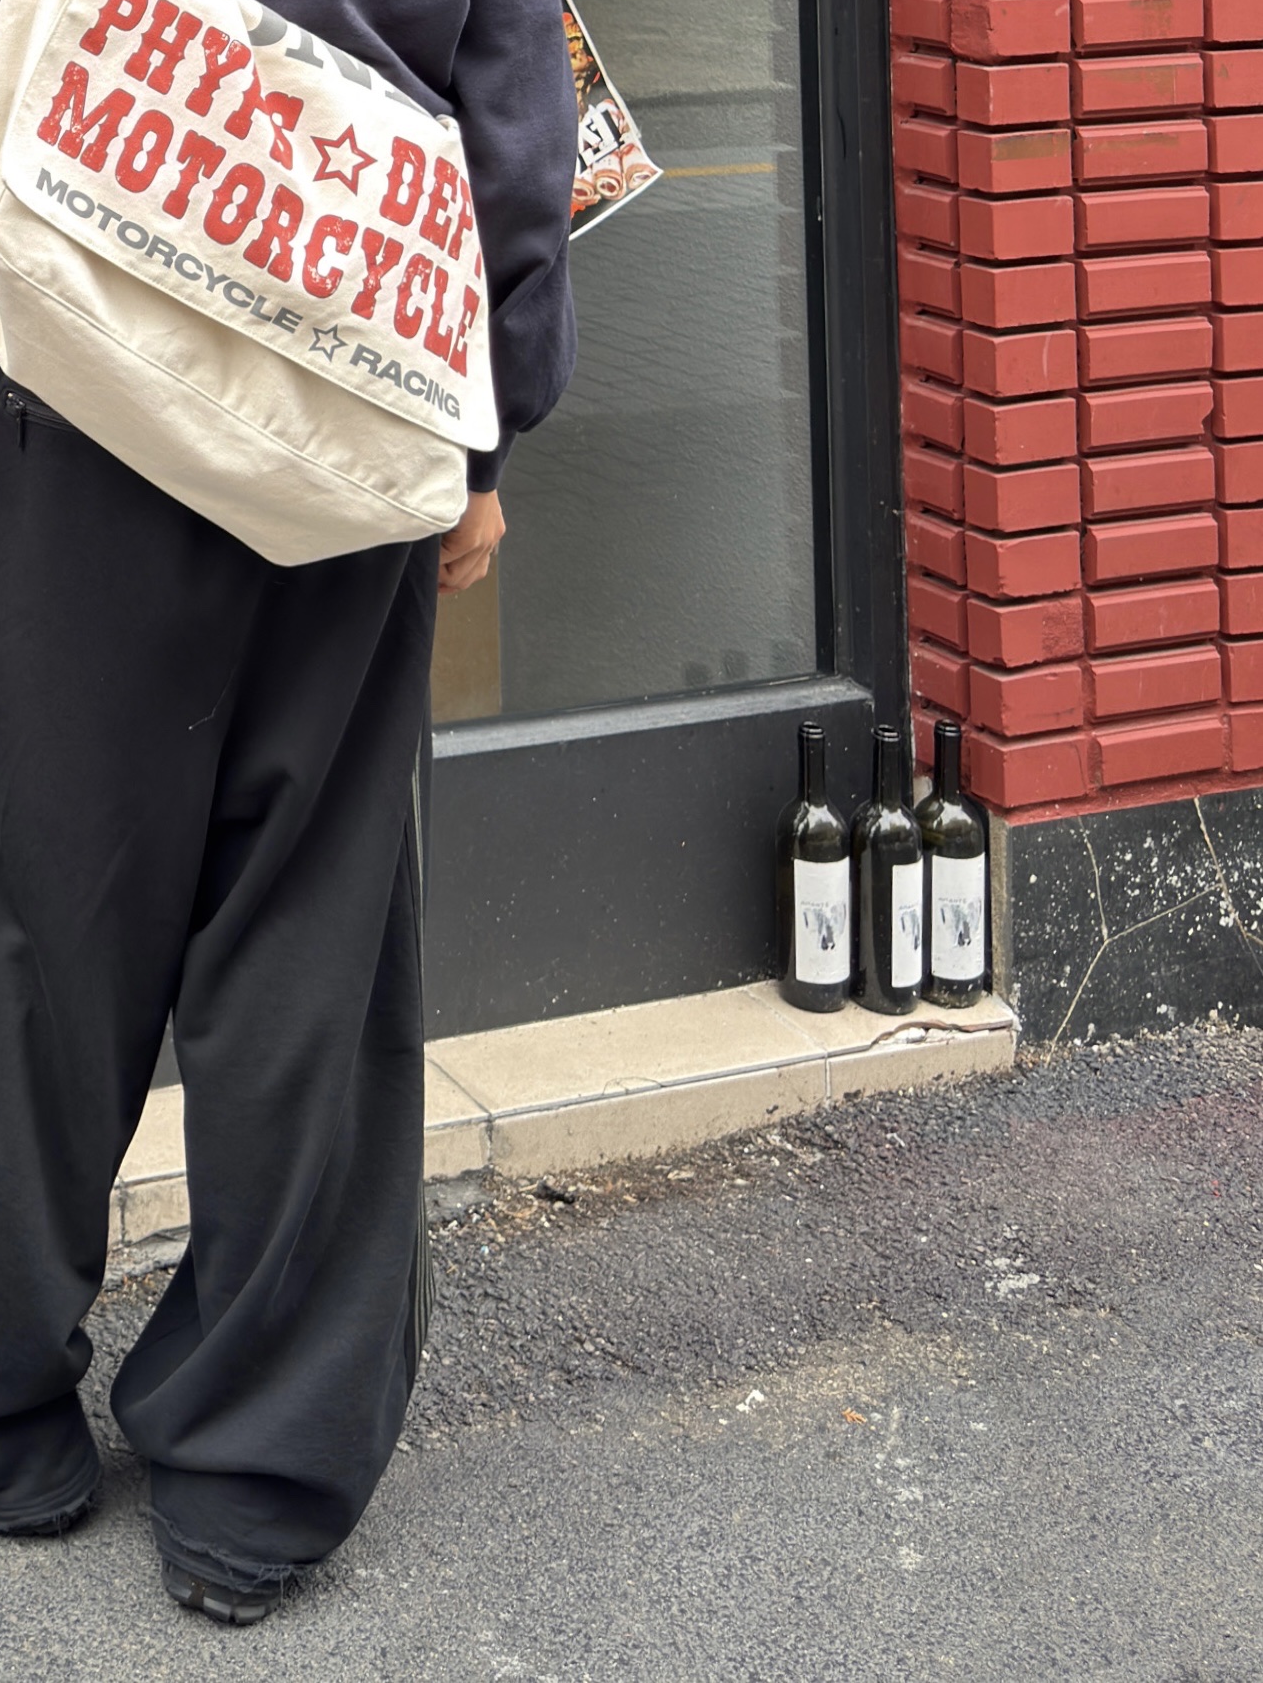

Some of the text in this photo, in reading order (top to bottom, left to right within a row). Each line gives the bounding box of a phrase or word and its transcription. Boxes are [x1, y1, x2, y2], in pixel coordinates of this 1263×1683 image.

[35, 167, 462, 420] MOTORCYCLE RACING
[36, 61, 480, 378] MOTORCYCLE
[380, 135, 482, 279] DEP
